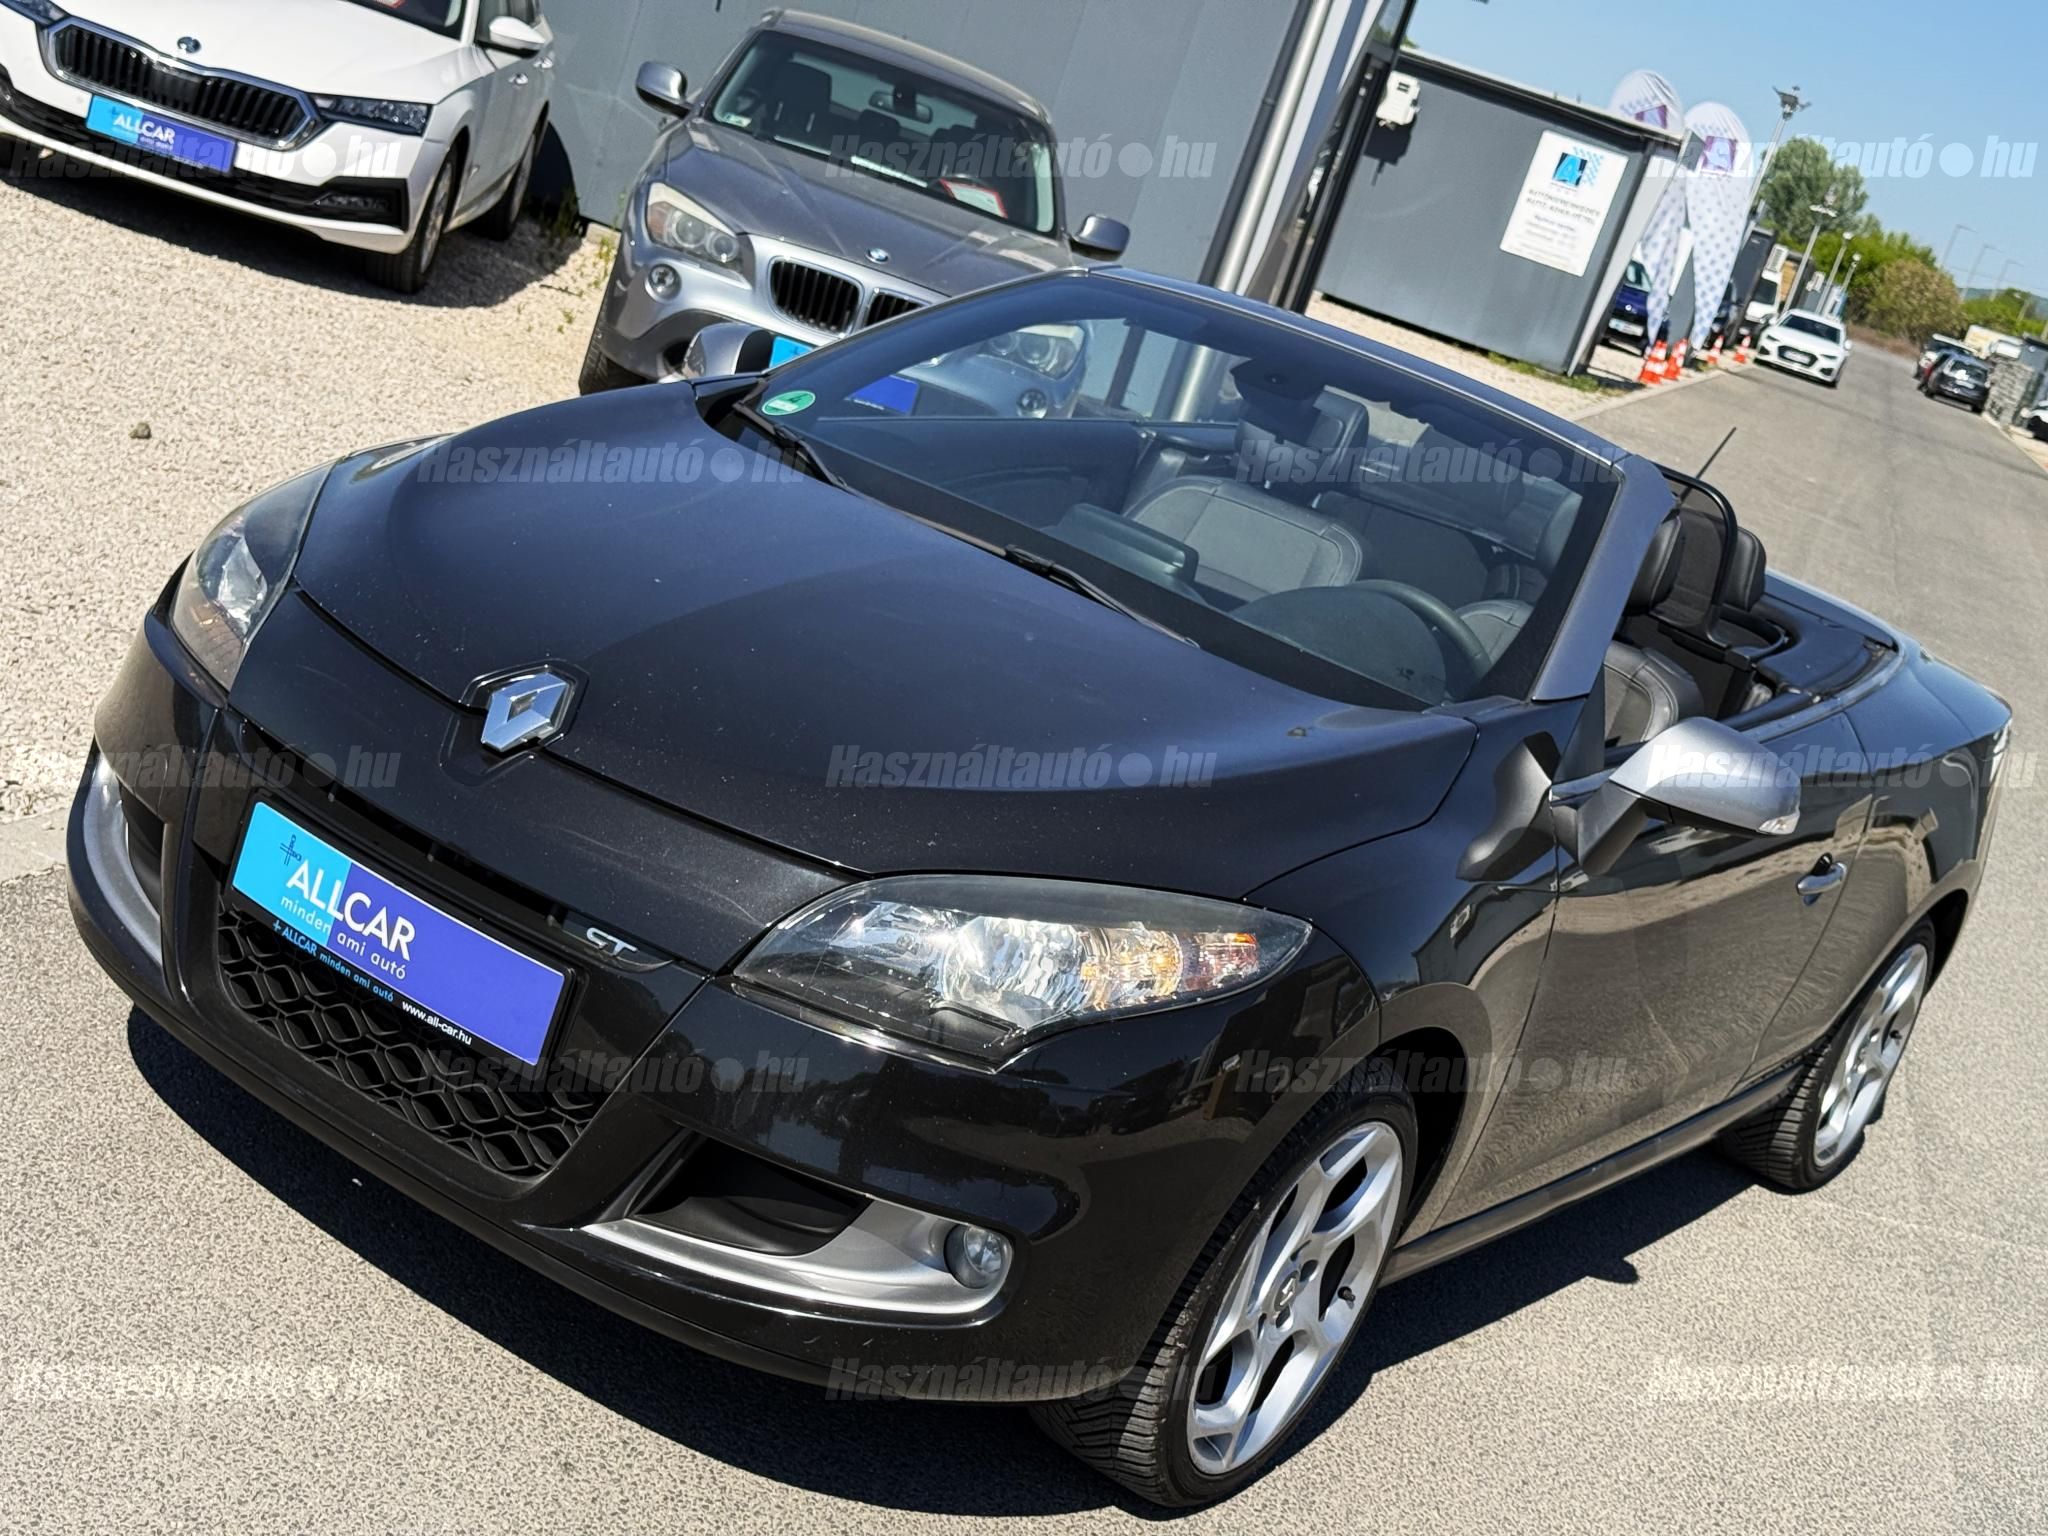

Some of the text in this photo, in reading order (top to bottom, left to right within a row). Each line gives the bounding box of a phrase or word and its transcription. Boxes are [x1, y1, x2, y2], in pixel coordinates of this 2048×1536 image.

[113, 112, 176, 145] ALLCAR
[281, 895, 407, 981] minden ami autó
[286, 859, 416, 962] ALLCAR
[282, 925, 395, 1003] ALLCAR minden ami autó
[586, 927, 639, 957] GT
[401, 1000, 473, 1046] www.all-car.hu
